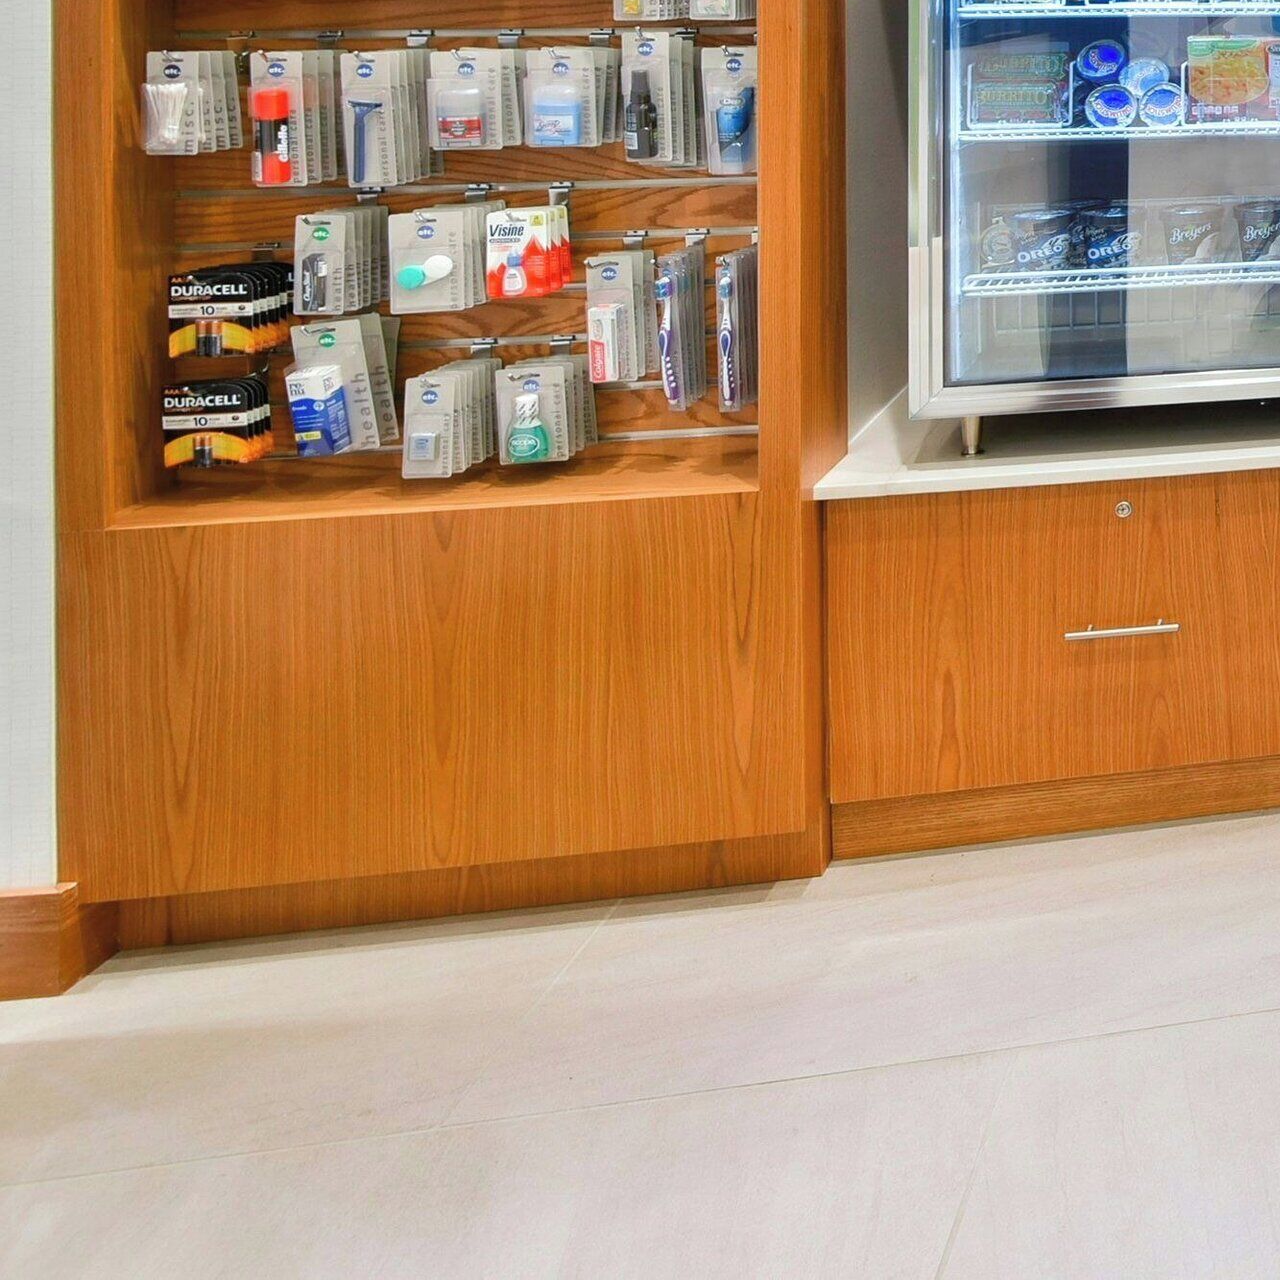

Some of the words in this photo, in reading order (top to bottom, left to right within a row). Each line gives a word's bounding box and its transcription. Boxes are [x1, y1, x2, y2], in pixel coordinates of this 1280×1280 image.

[486, 67, 496, 91] care
[502, 65, 512, 91] care
[582, 67, 590, 91] care
[183, 100, 195, 154] misc.
[229, 96, 237, 146] misc.
[289, 109, 299, 132] care
[304, 107, 314, 130] care
[486, 97, 497, 146] personal
[504, 95, 516, 142] personal
[581, 95, 592, 144] personal
[290, 135, 301, 185] personal
[306, 135, 317, 182] personal
[378, 136, 391, 185] personal
[488, 223, 524, 238] Visine
[1169, 222, 1213, 245] Breyers
[1018, 244, 1063, 263] OREO
[1087, 242, 1132, 260] OREO
[171, 284, 248, 297] DURACELL
[332, 266, 342, 312] health
[200, 305, 215, 316] 10
[592, 345, 603, 380] Colgate
[163, 395, 240, 408] DURACELL
[369, 364, 398, 440] health
[552, 382, 561, 406] care
[192, 416, 208, 427] 10
[351, 371, 376, 448] health
[550, 410, 565, 459] personal
